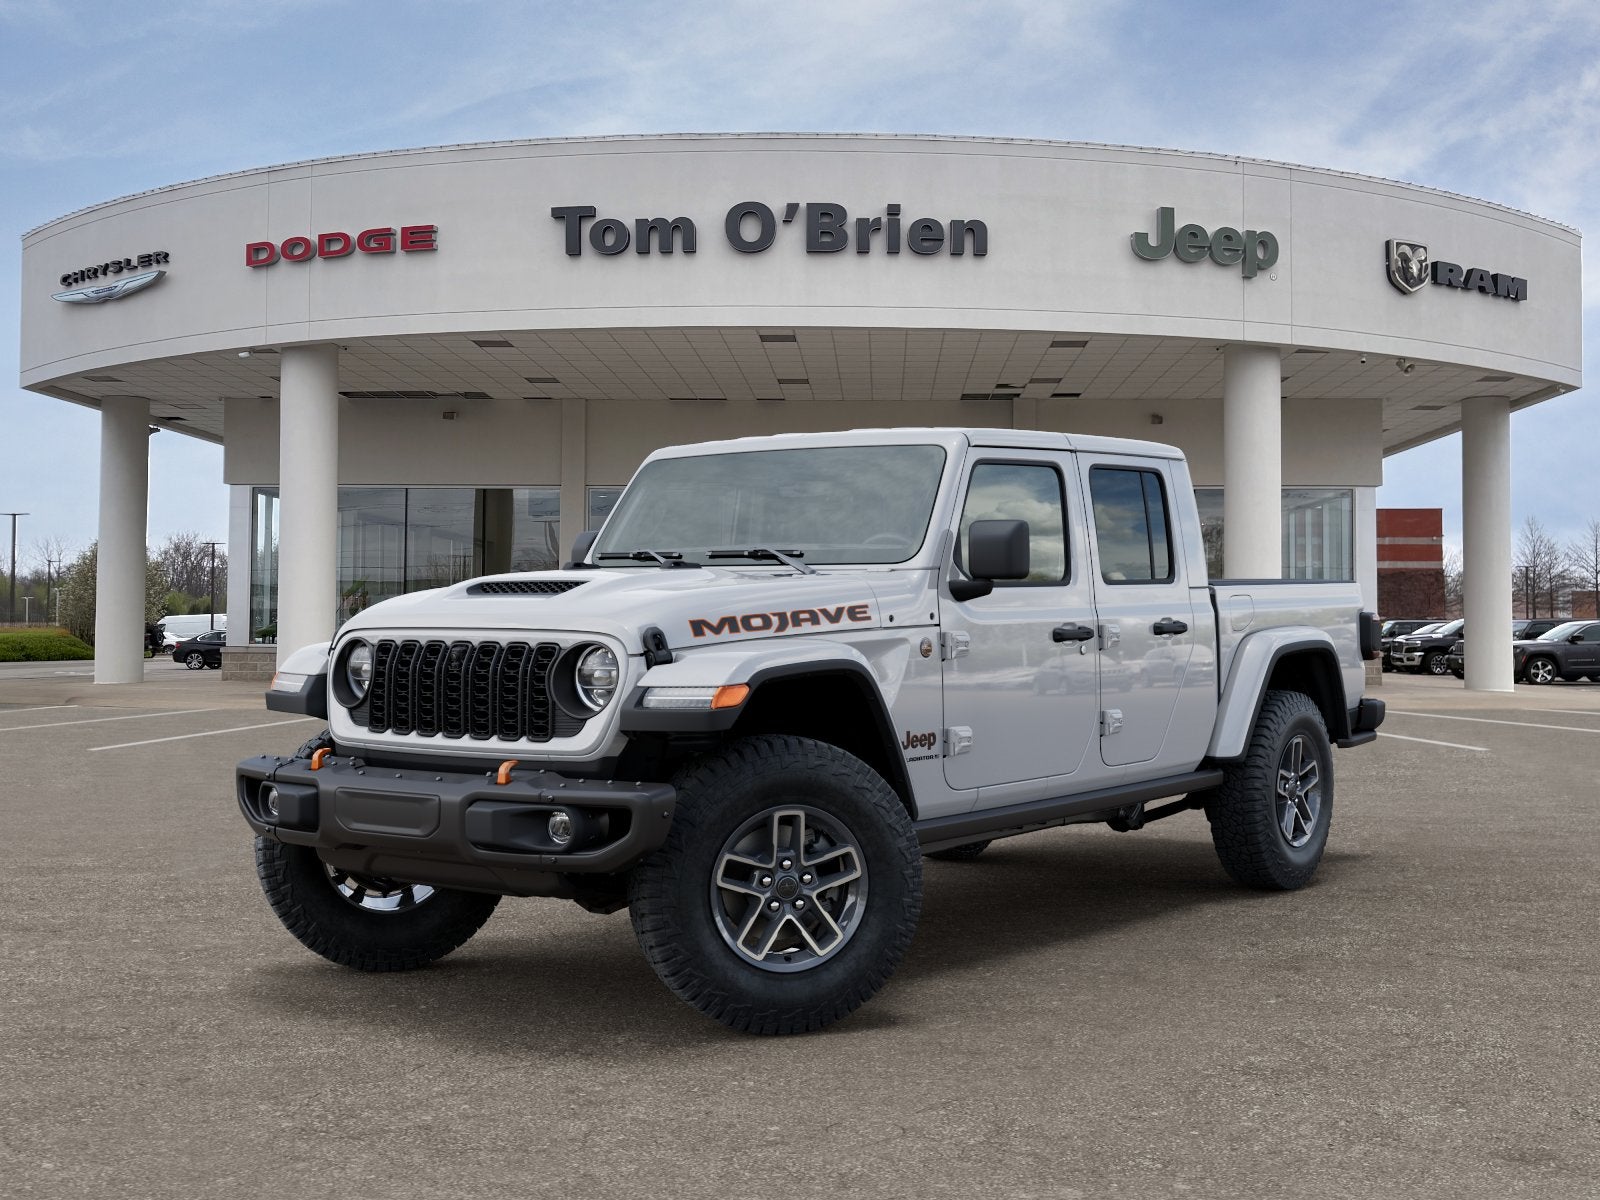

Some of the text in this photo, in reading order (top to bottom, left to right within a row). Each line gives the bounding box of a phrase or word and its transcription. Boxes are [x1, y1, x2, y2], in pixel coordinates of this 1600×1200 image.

[246, 225, 438, 268] DODGE
[551, 201, 988, 256] Tom O'Brien
[1131, 206, 1279, 278] Jeep
[60, 251, 169, 286] CHRYSLER
[1431, 261, 1528, 301] RAM
[688, 604, 872, 638] MOJAVE
[902, 731, 937, 750] Jeep
